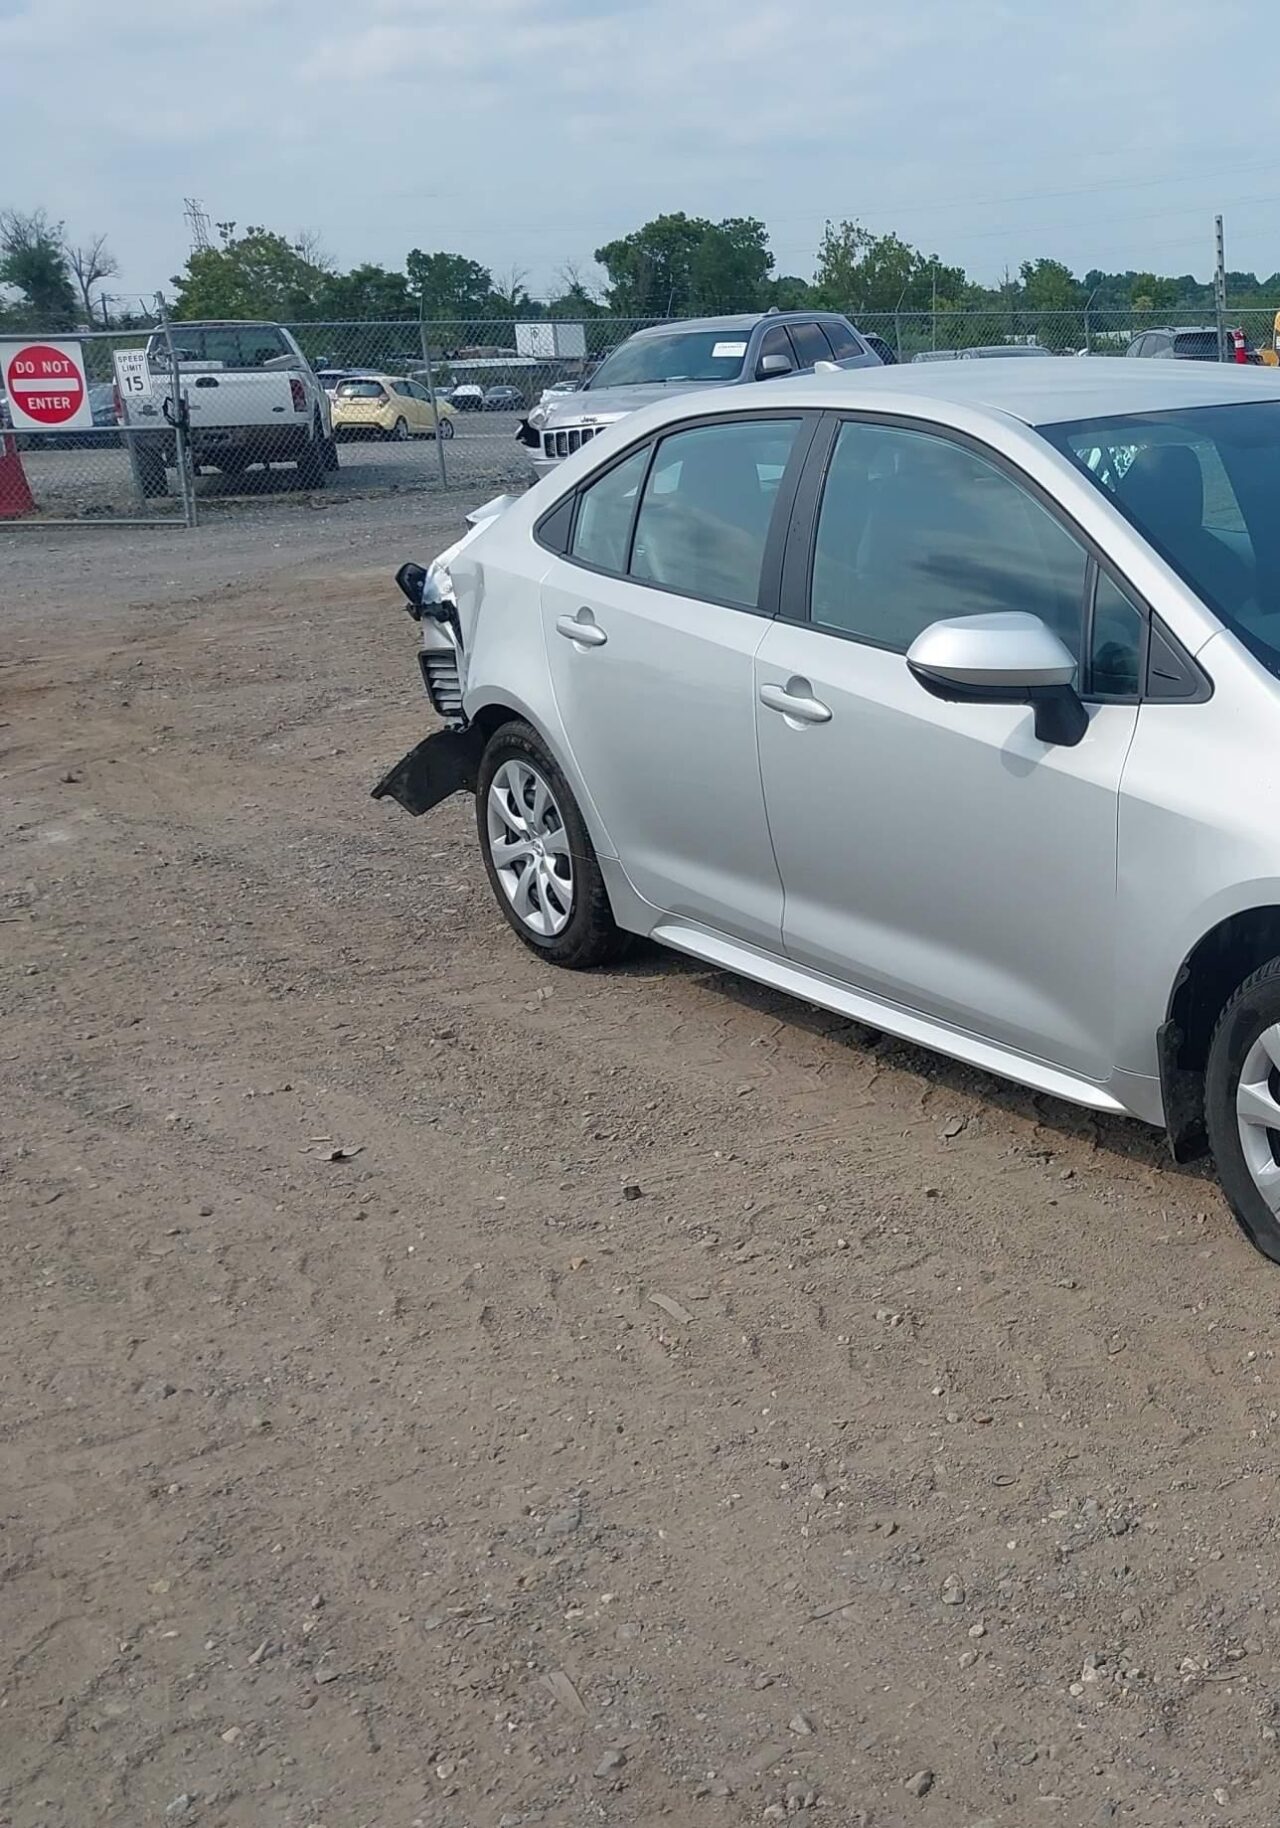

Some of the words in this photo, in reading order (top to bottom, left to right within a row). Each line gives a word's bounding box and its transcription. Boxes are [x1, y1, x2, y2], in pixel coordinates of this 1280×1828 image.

[118, 355, 144, 363] SPEED
[15, 361, 35, 374] DO
[42, 360, 69, 373] NOT
[122, 364, 142, 372] LIMIT
[125, 376, 144, 392] 15
[27, 397, 71, 410] ENTER
